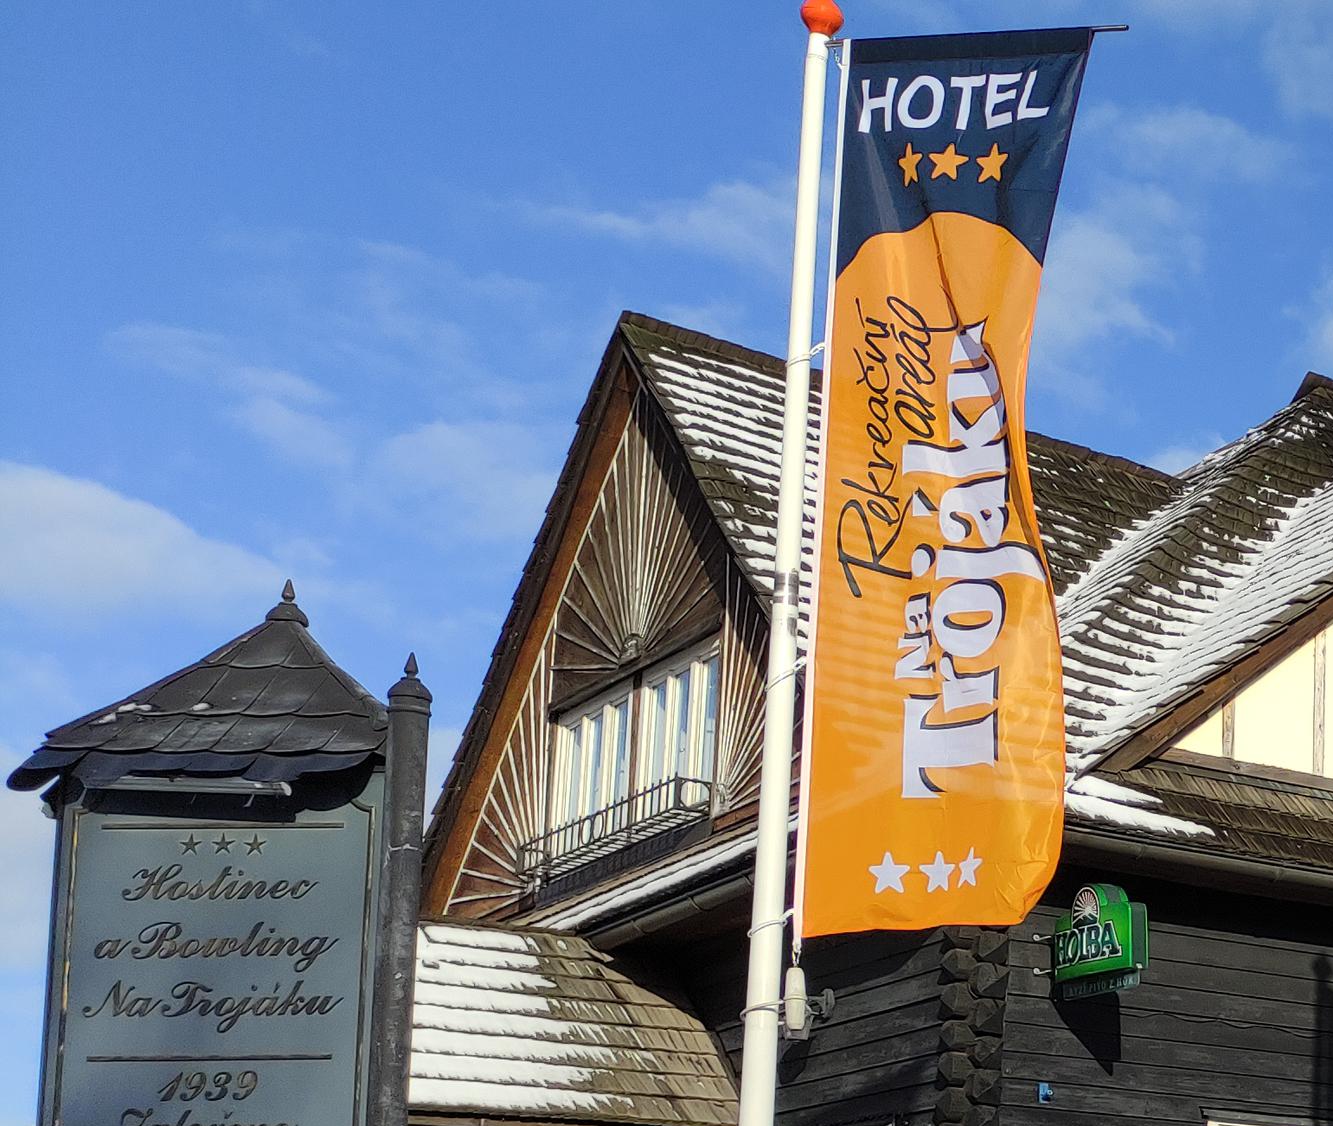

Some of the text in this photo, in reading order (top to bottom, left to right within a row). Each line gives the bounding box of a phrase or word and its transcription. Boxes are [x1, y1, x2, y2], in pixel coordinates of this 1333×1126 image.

[857, 70, 1051, 134] HOTEL
[893, 285, 962, 438] areál
[836, 297, 912, 599] Rekreační
[894, 315, 1048, 799] Na Trojáku
[121, 863, 319, 902] Hostinec
[94, 921, 340, 973] a Bowling
[1054, 920, 1122, 968] HOLBA
[82, 979, 345, 1034] Na Trojáku
[158, 1070, 259, 1102] 1939
